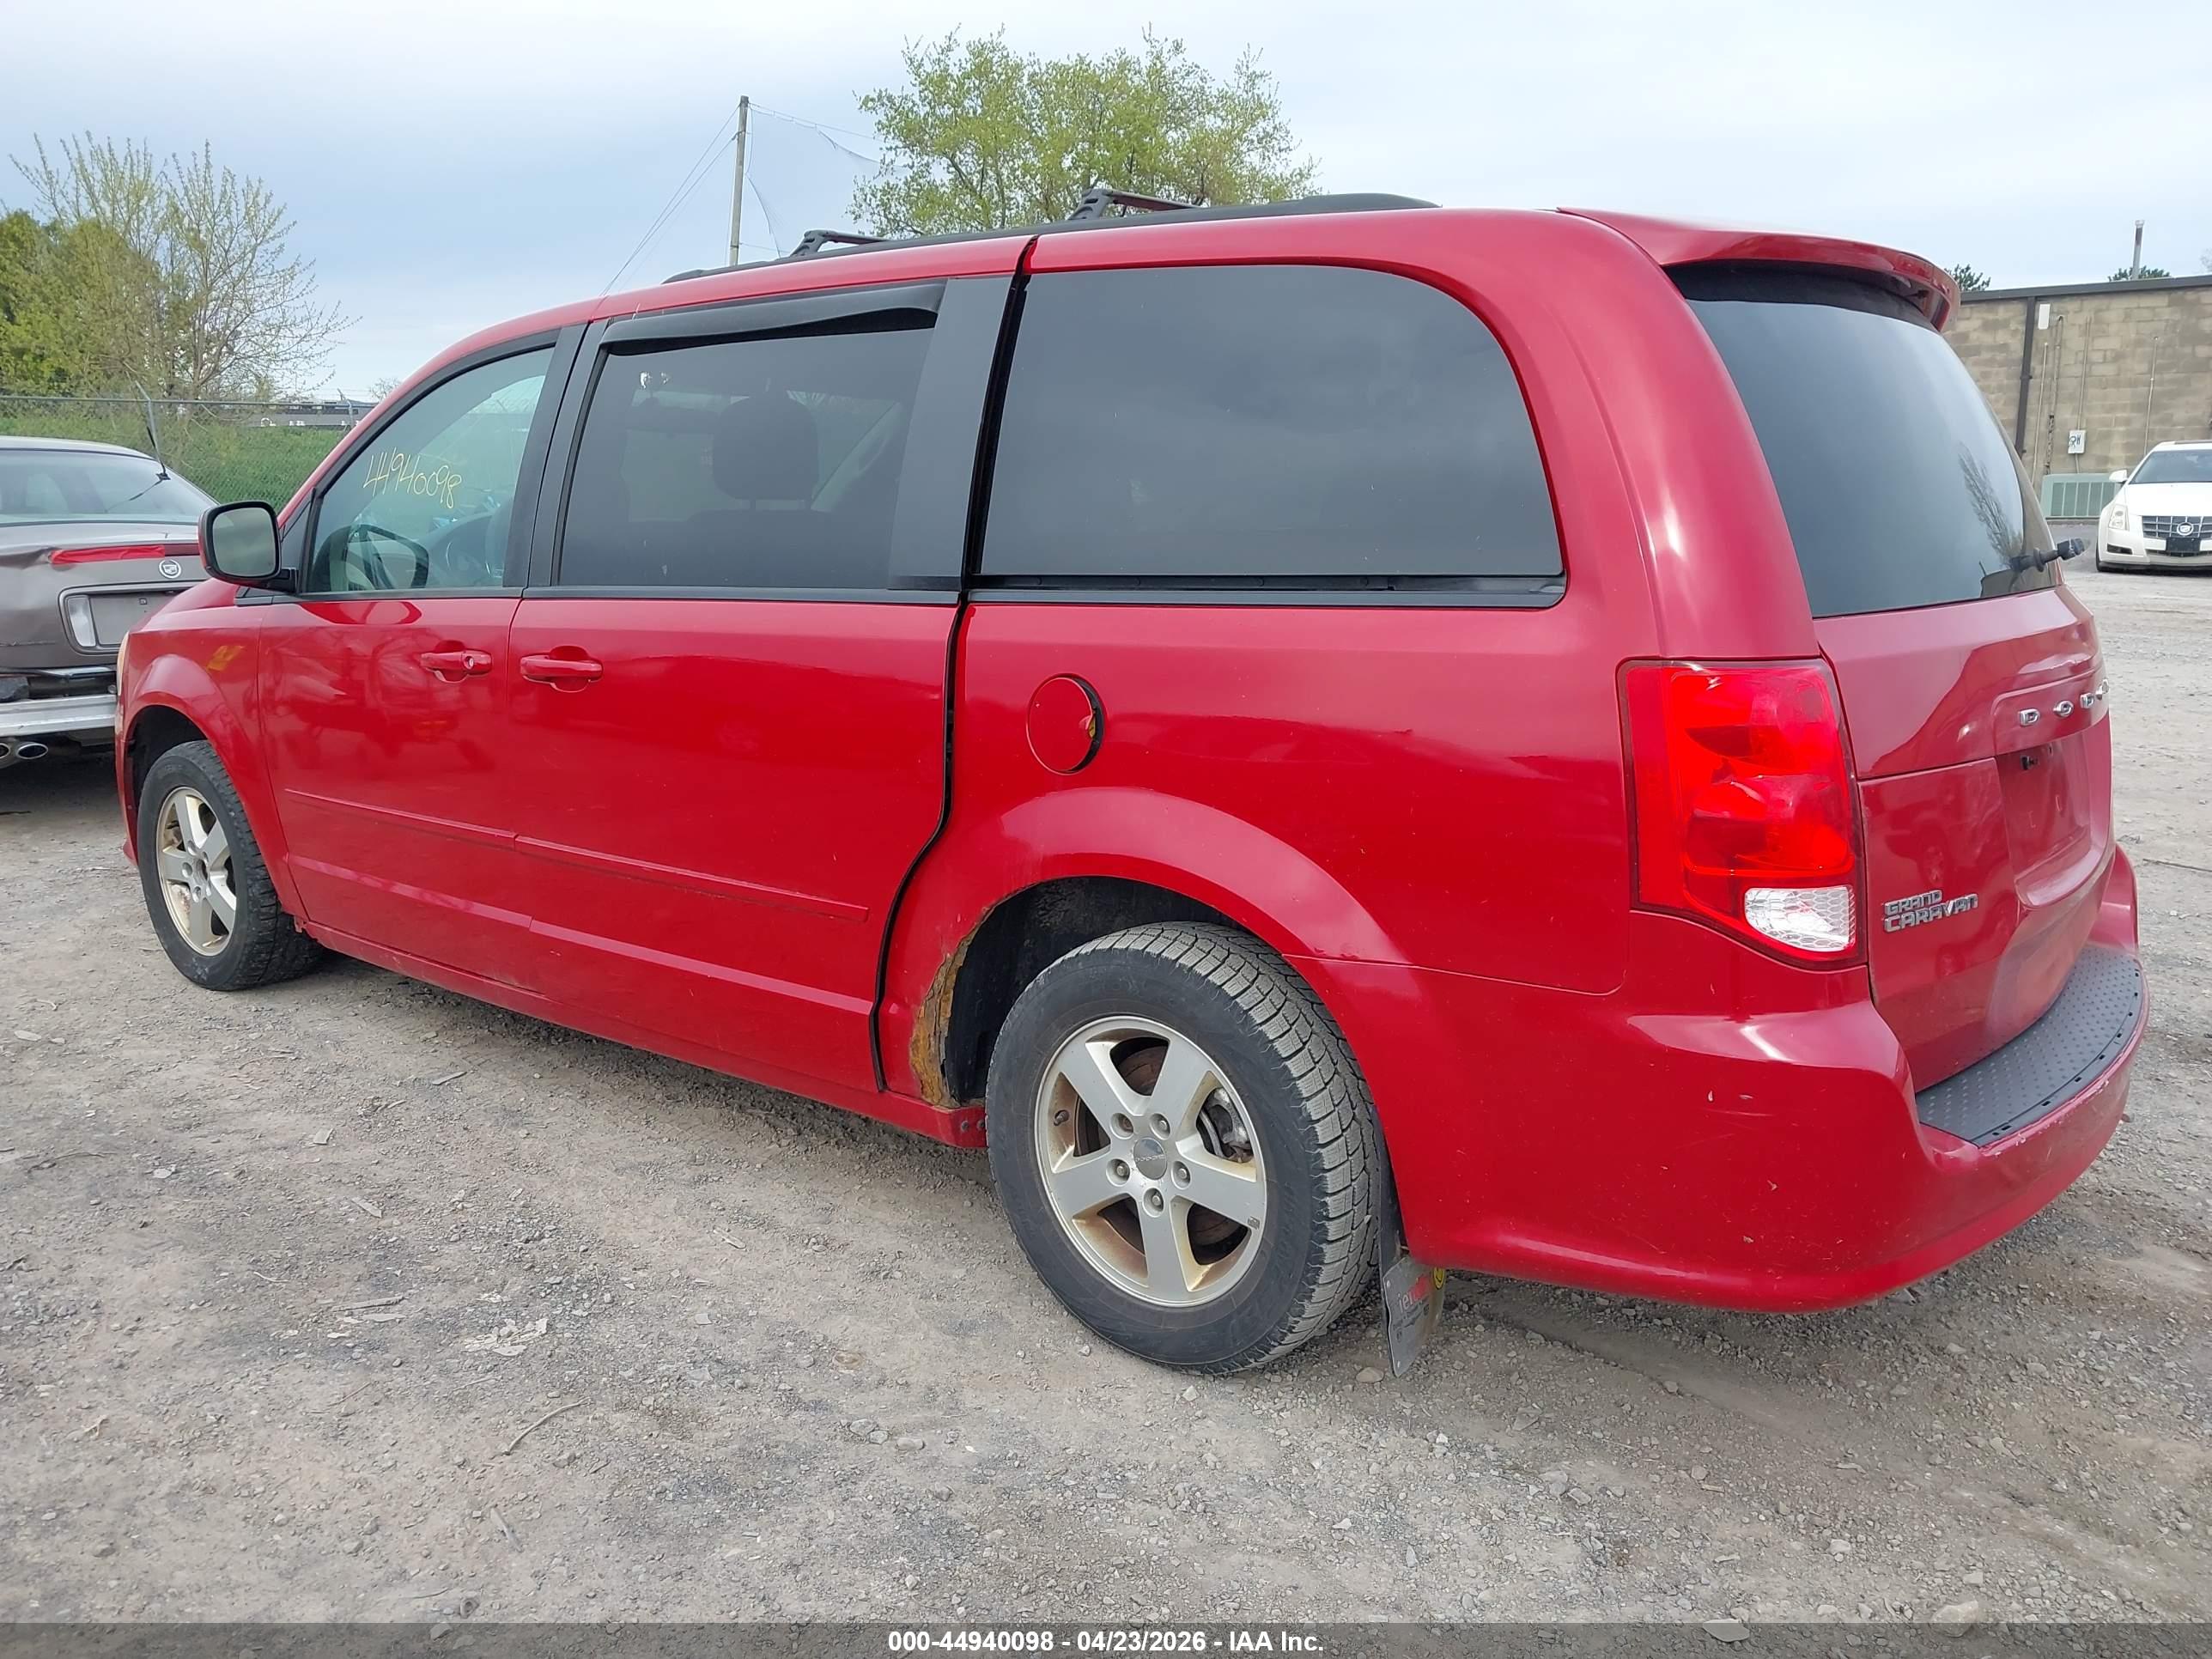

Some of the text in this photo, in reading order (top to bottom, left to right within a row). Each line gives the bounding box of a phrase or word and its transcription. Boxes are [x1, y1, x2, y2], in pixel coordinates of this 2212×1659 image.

[363, 447, 462, 509] 44940098
[1884, 890, 1942, 916] GRAND
[1884, 893, 1978, 933] CARAVAN
